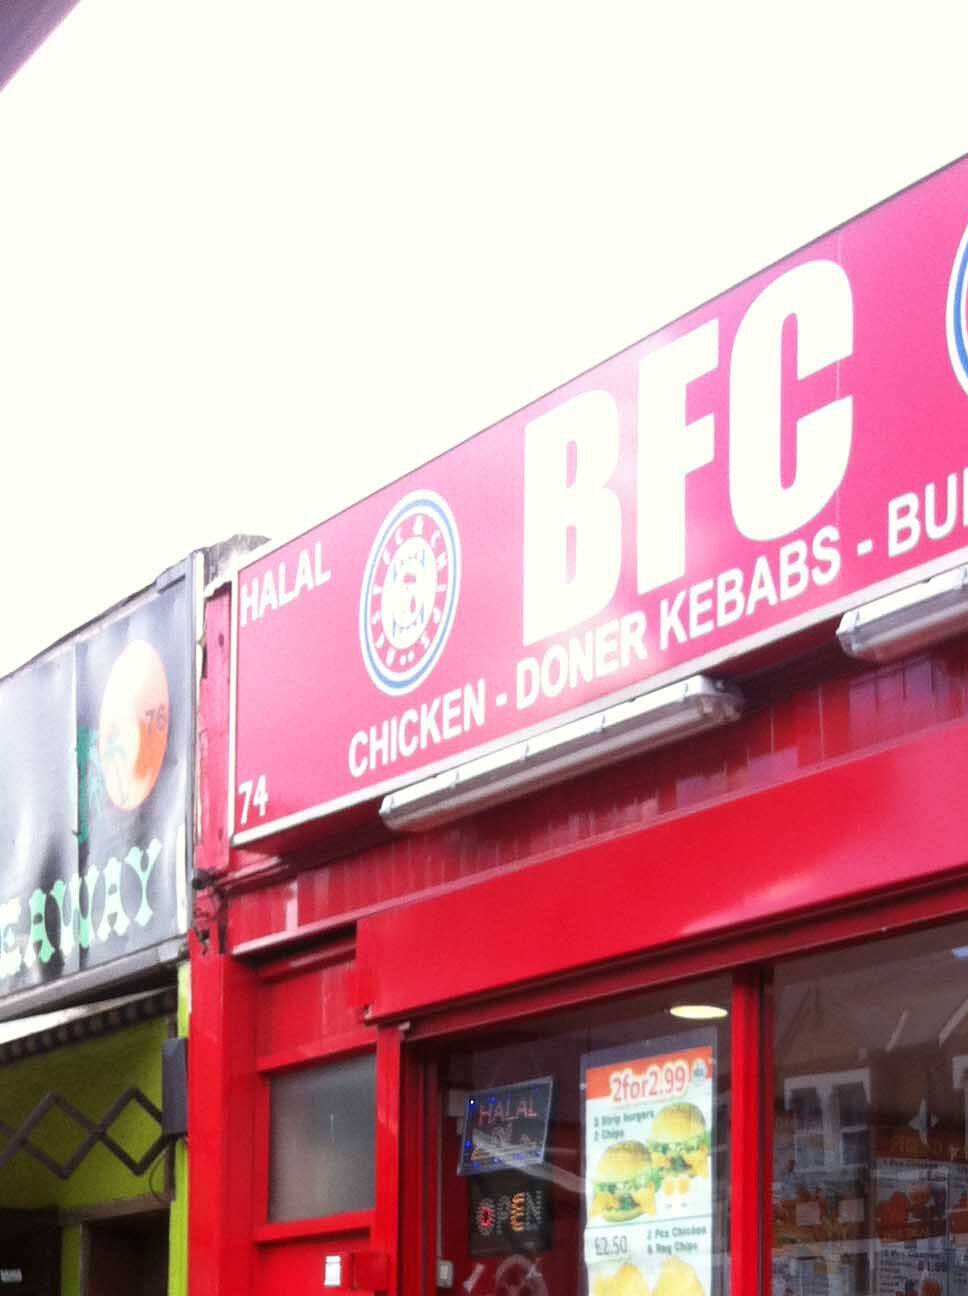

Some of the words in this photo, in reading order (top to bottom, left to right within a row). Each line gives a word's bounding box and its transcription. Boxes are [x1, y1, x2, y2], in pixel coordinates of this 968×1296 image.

[523, 260, 854, 648] BFC
[240, 543, 331, 628] HALAL
[348, 678, 486, 778] CHICKEN
[517, 615, 648, 710] DONER
[660, 526, 841, 652] KEBABS
[238, 775, 269, 825] 74
[479, 1100, 537, 1127] HALAL
[475, 1190, 543, 1237] OPEN
